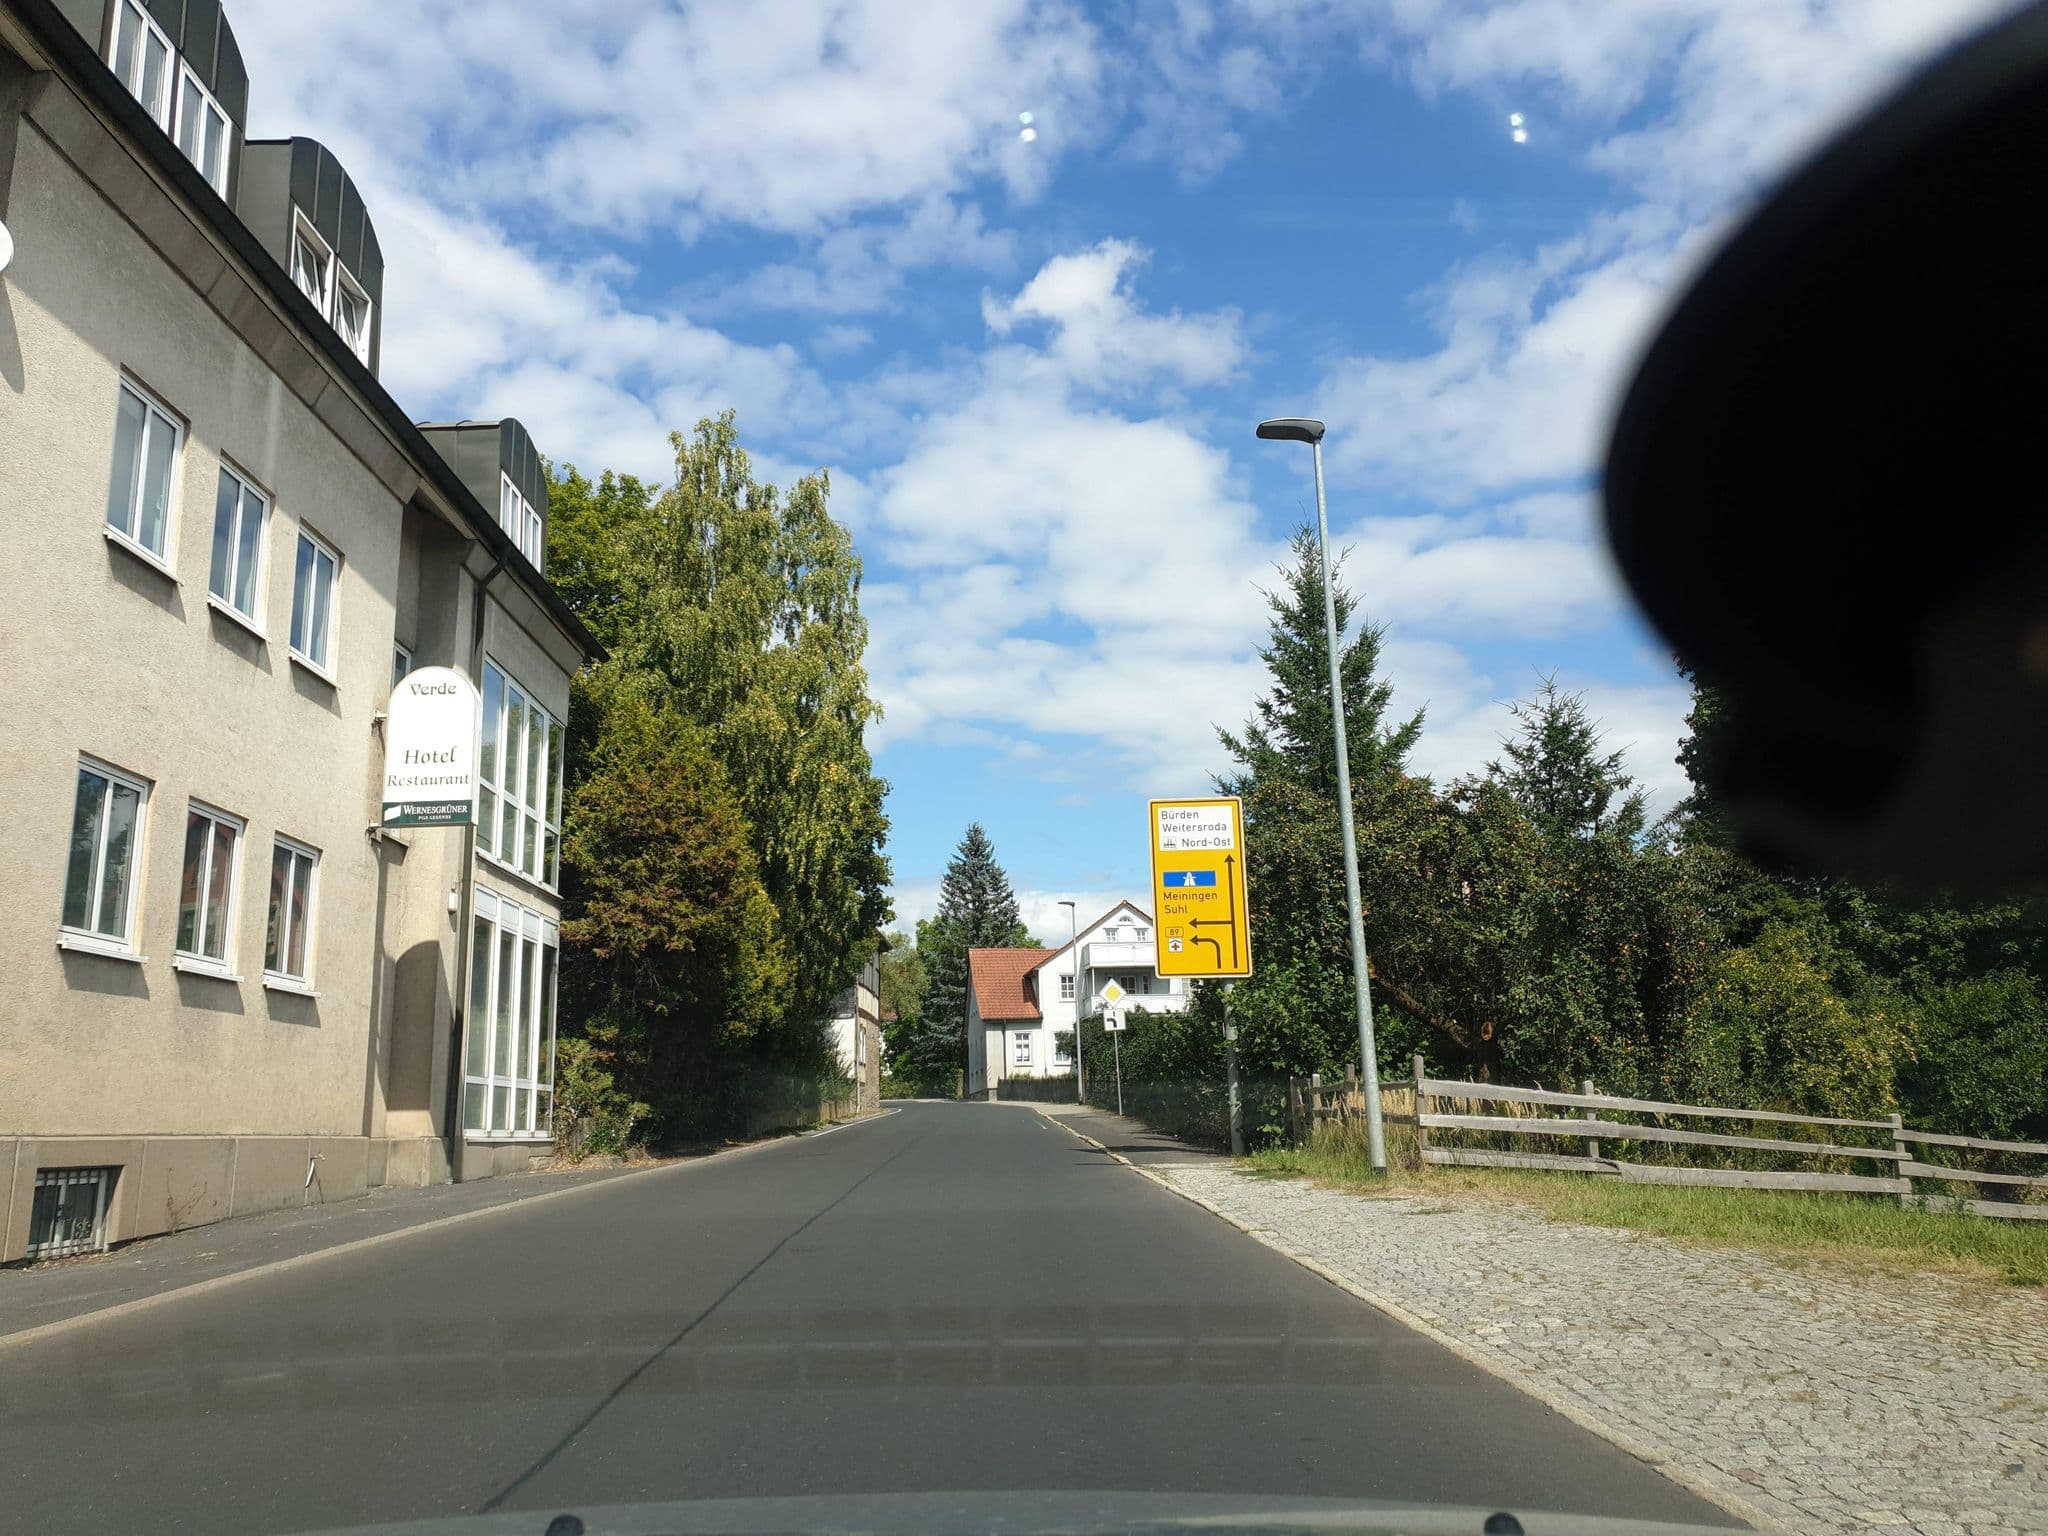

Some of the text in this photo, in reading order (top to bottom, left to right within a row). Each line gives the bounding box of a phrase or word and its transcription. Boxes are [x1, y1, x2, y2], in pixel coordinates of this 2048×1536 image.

[410, 683, 457, 696] Verde
[404, 745, 457, 765] Hotel
[387, 773, 470, 787] Restaurant
[403, 804, 468, 815] WERNESGRÜNER
[1161, 810, 1199, 820] Bürden
[1162, 822, 1227, 833] Weitersroda
[1181, 837, 1231, 848] Nord-Ost
[1163, 891, 1218, 903] Meiningen
[1164, 904, 1188, 914] Suhl
